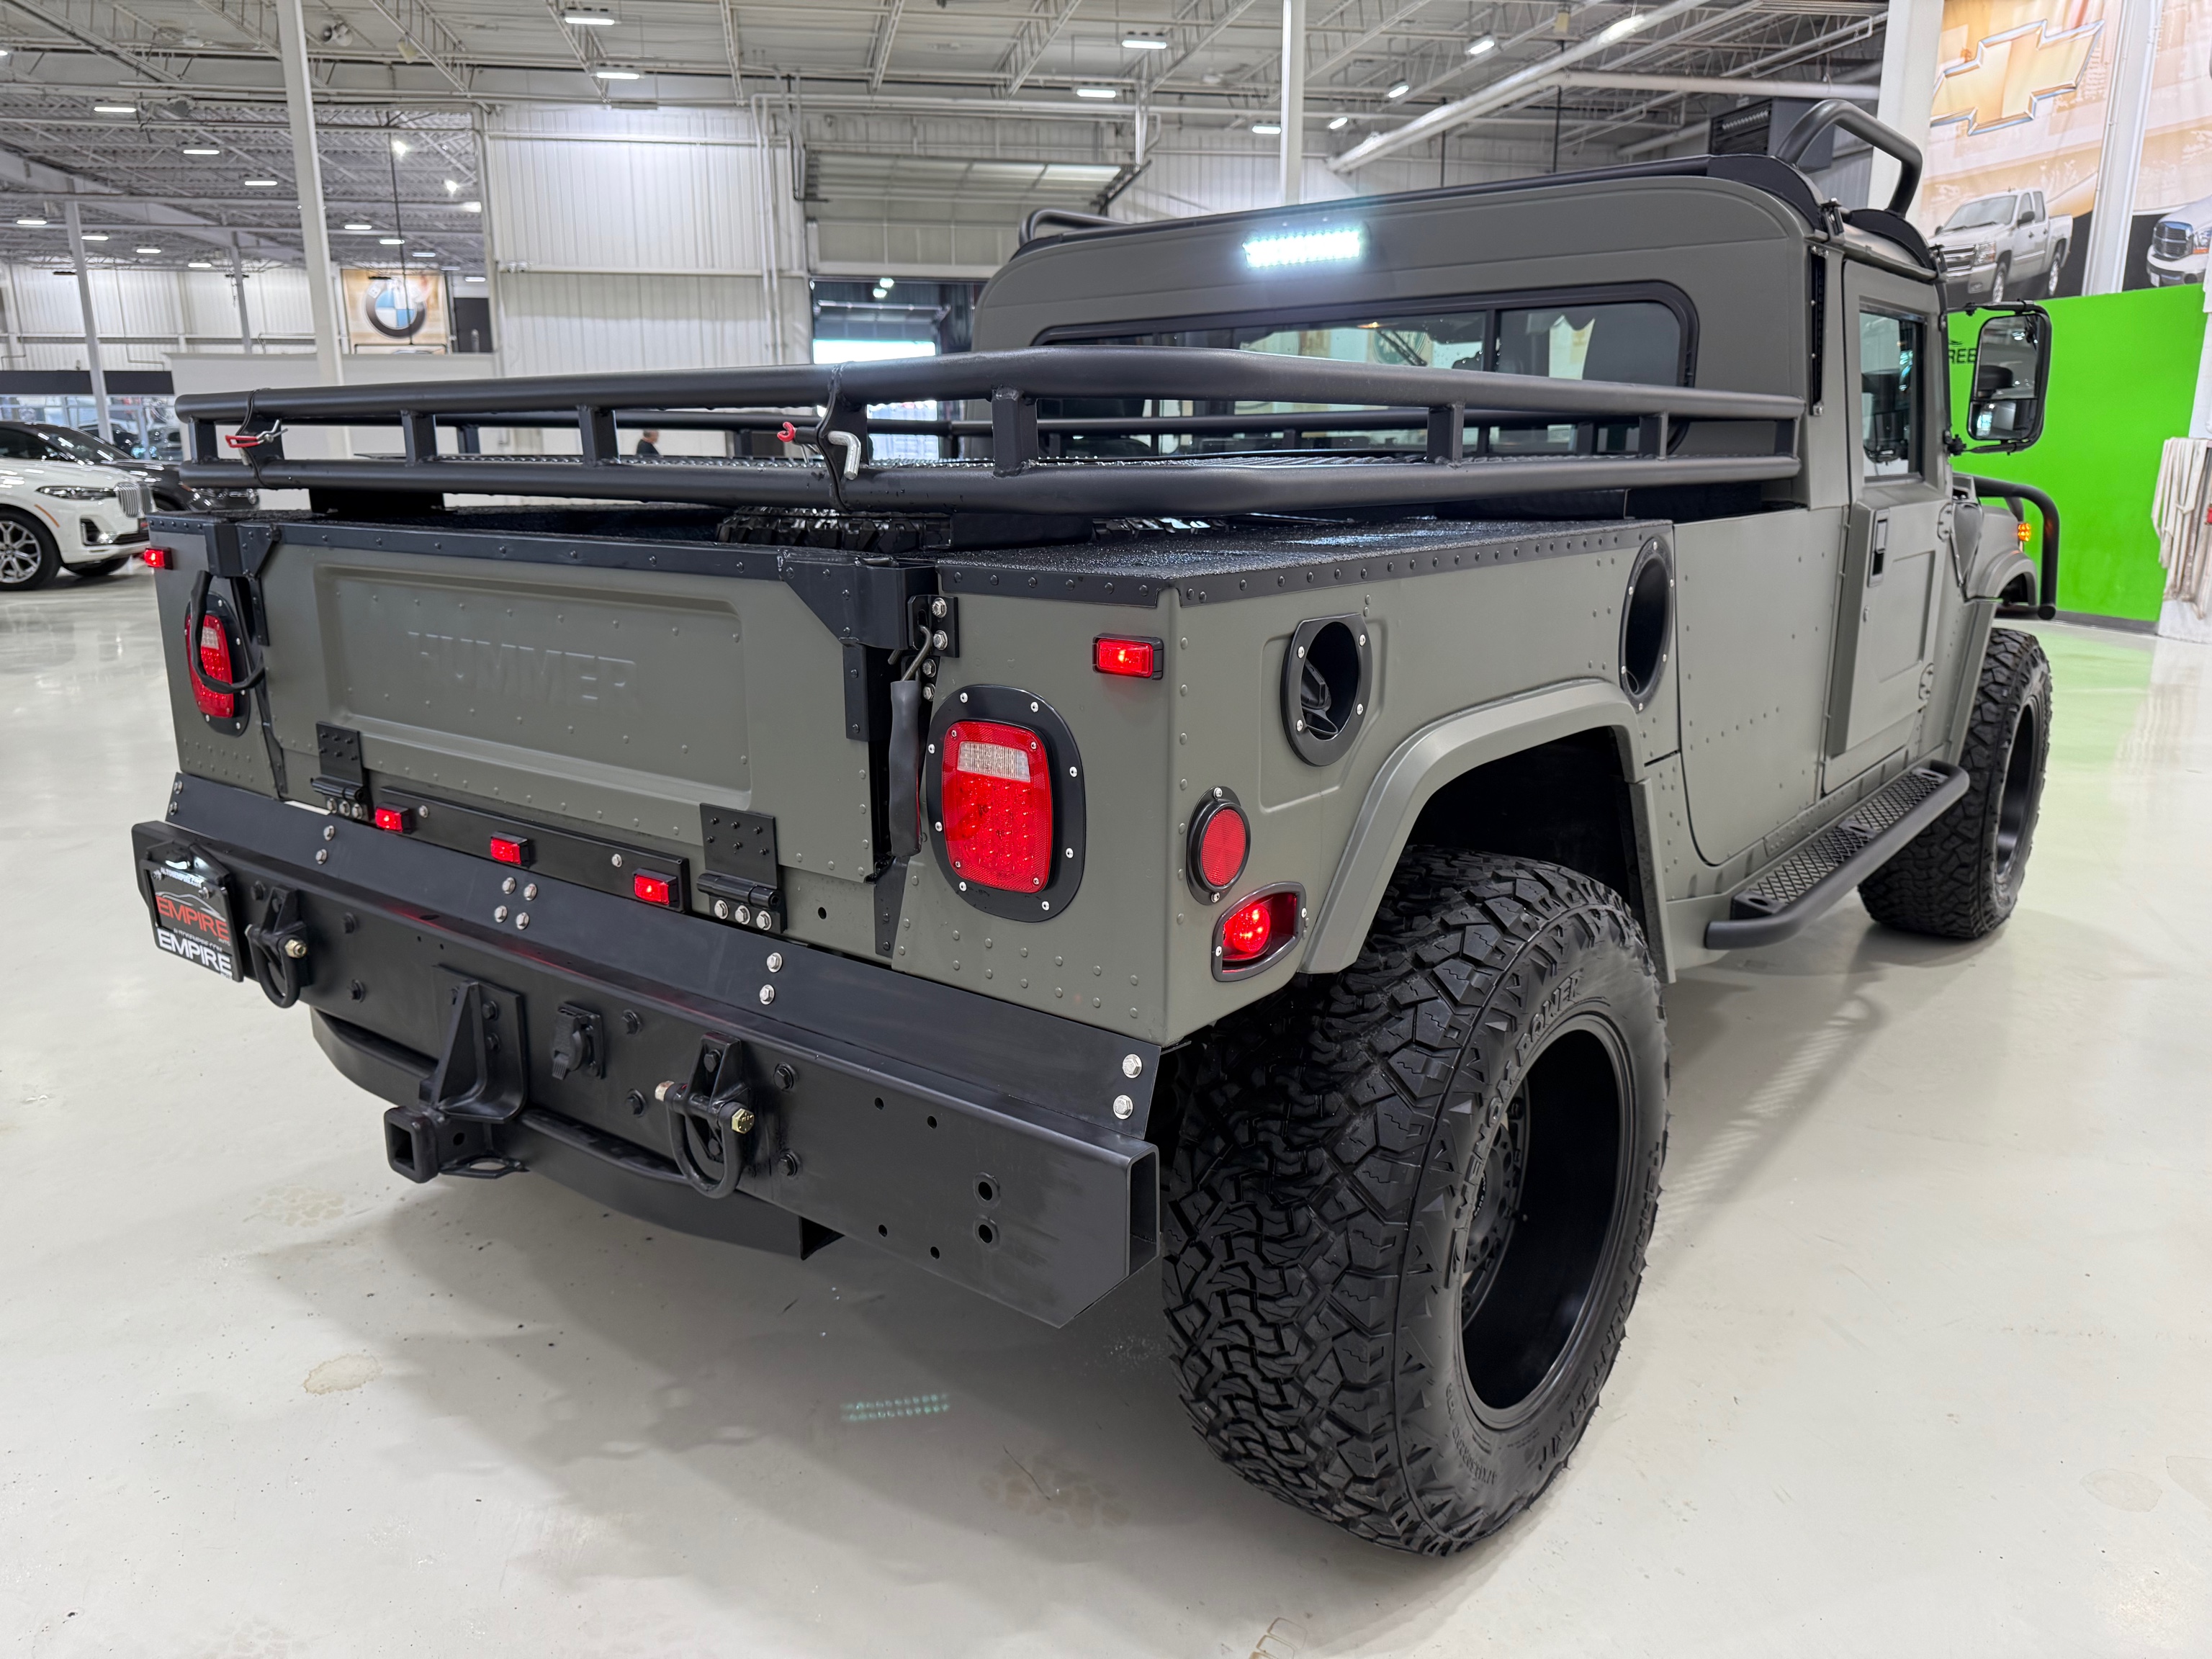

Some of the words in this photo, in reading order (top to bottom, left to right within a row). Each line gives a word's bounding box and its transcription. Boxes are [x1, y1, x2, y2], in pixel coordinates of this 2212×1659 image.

[156, 895, 230, 940] EMPIRE
[157, 927, 233, 976] EMPIRE
[1516, 969, 1584, 1068] POWER
